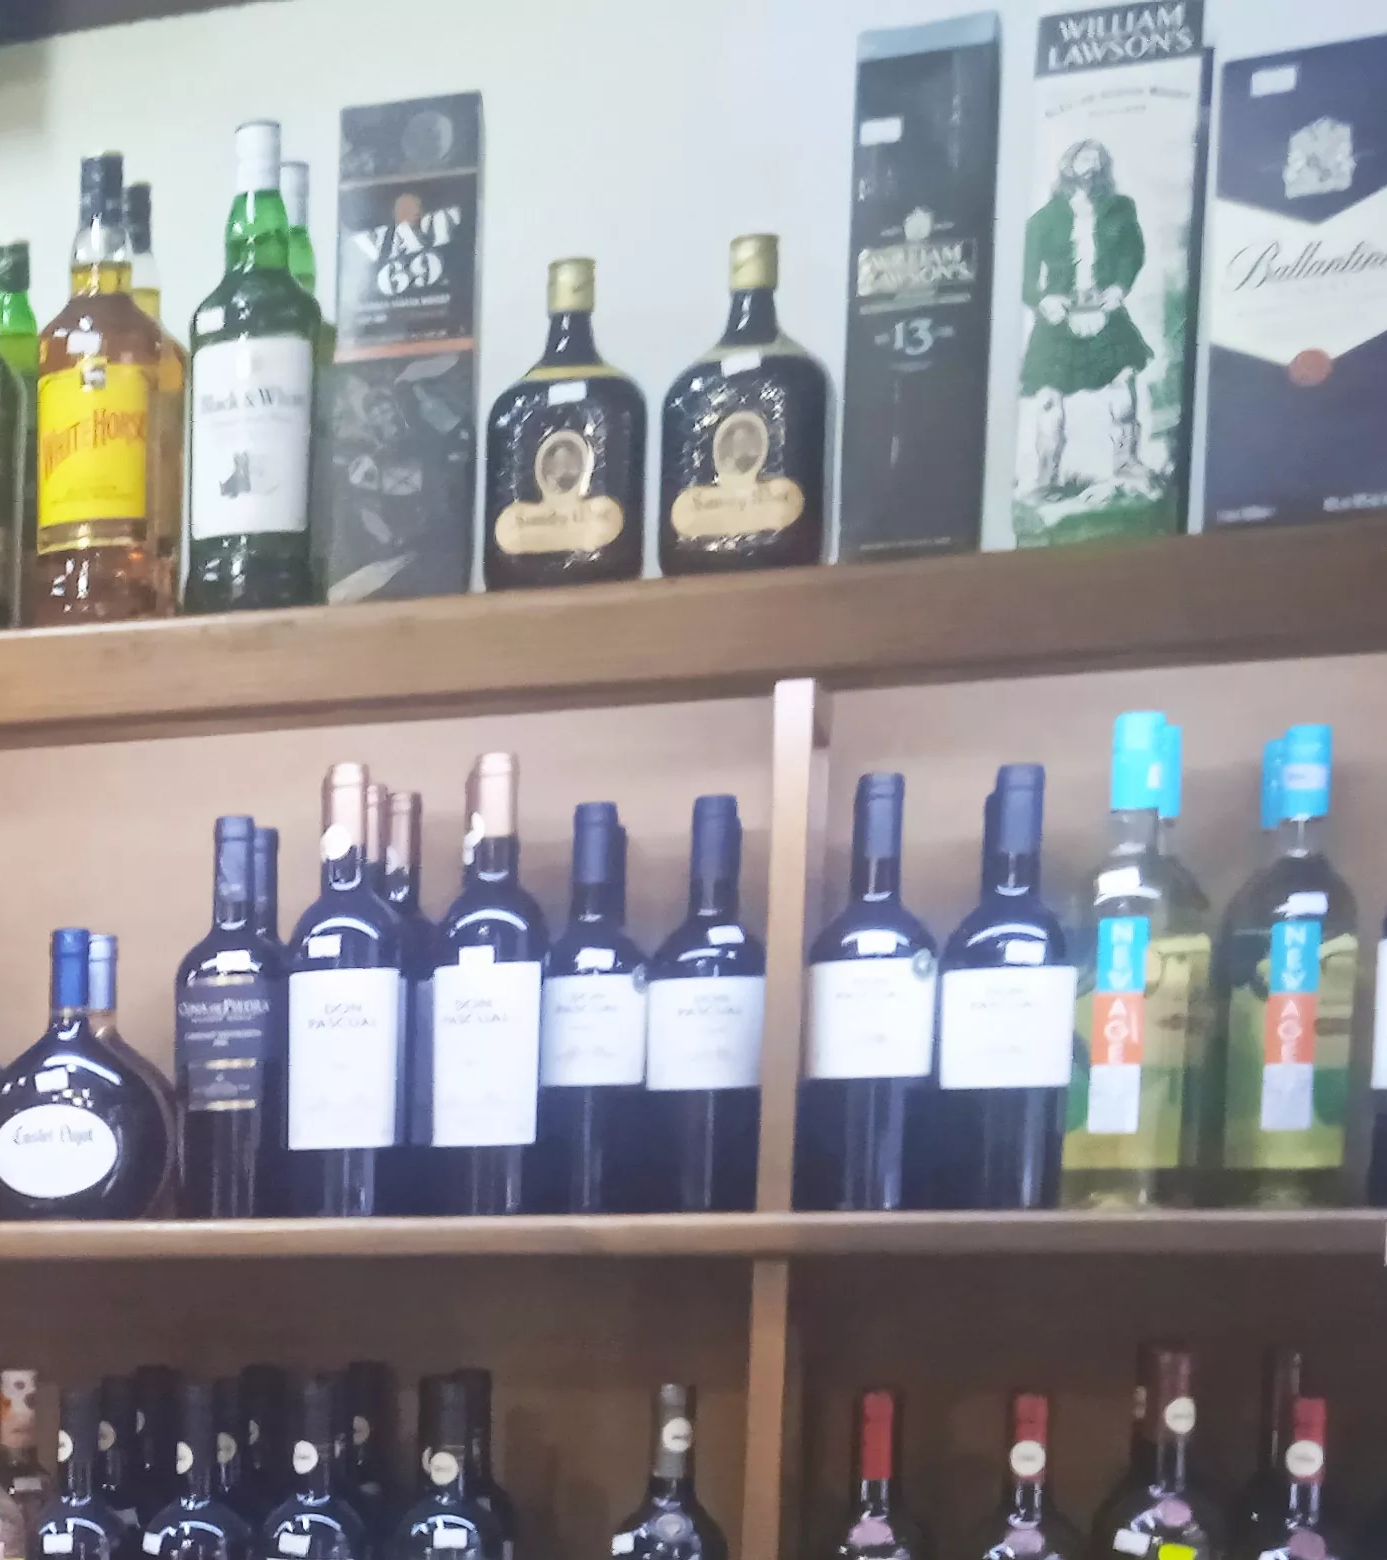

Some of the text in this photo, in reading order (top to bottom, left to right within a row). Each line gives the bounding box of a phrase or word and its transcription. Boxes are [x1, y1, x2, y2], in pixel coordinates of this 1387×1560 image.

[353, 206, 462, 261] VAT
[376, 252, 444, 296] 69
[894, 318, 933, 355] 13
